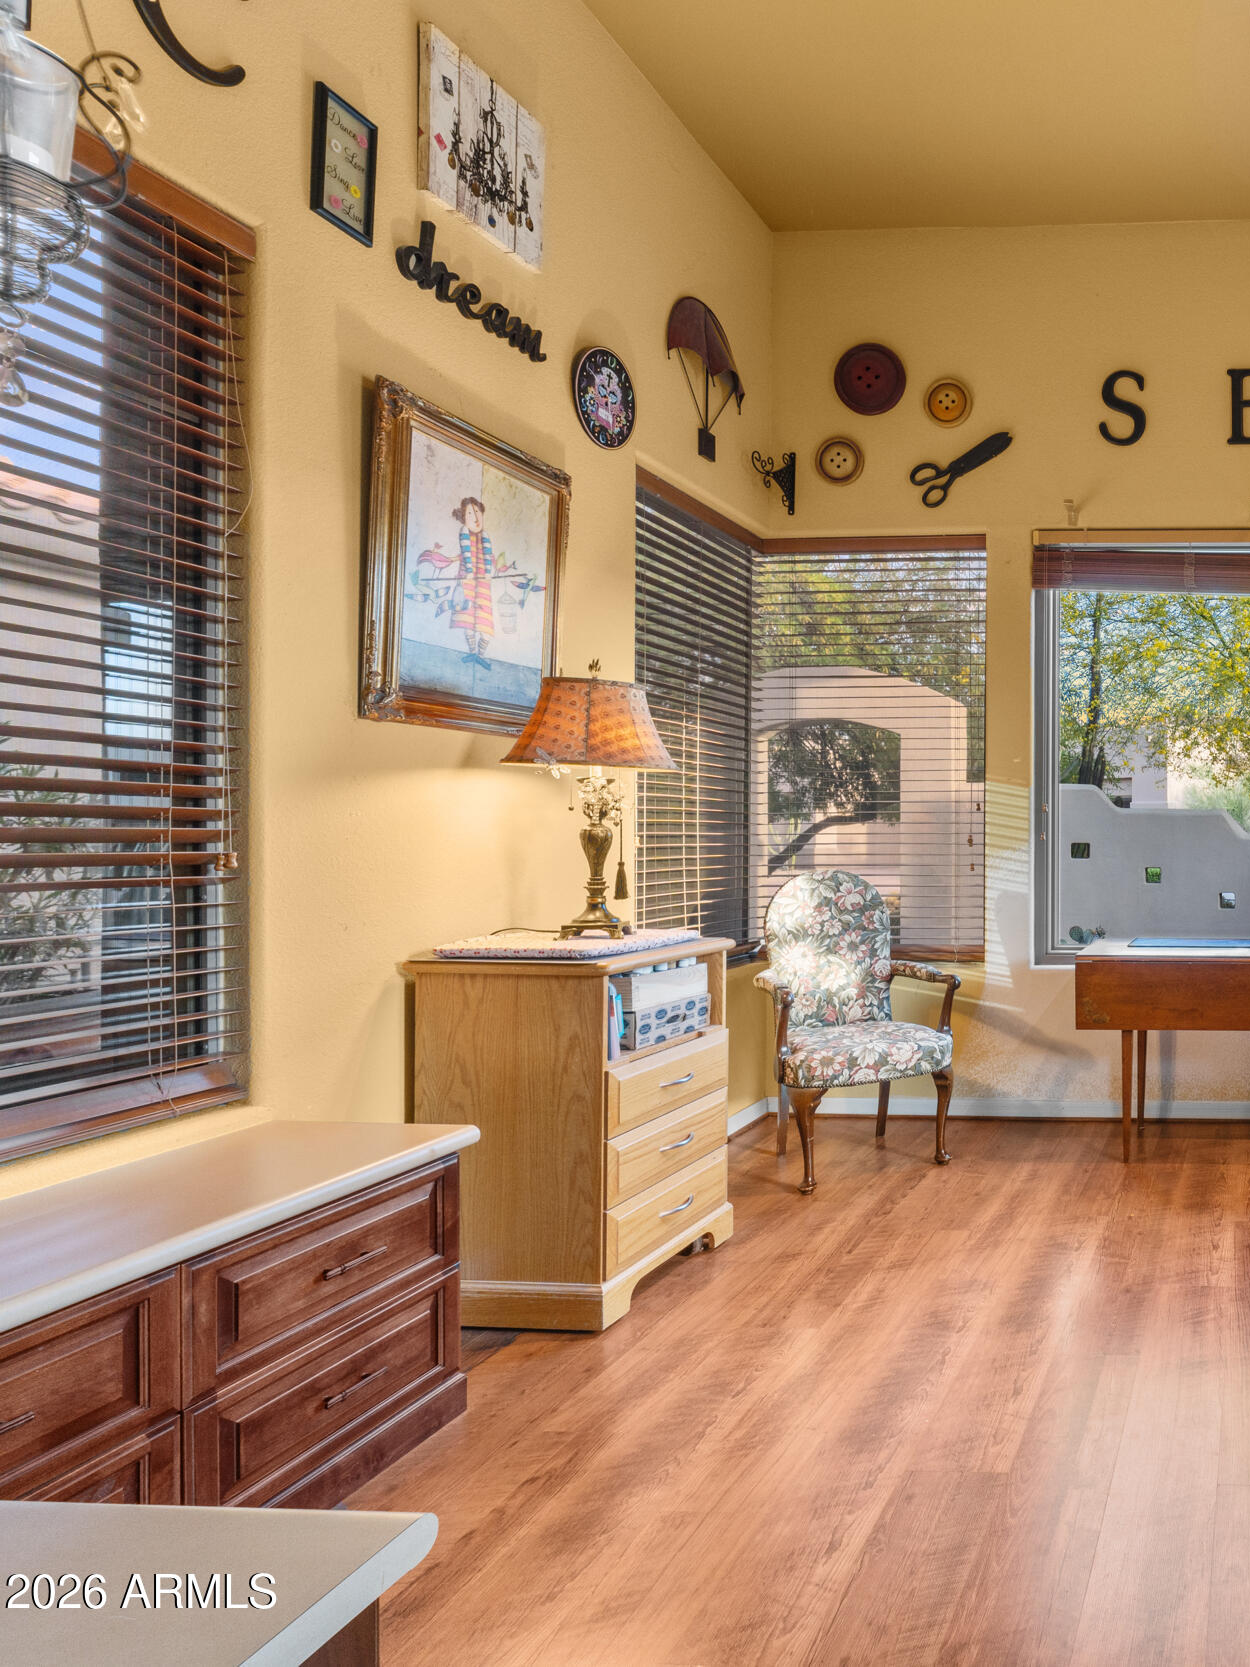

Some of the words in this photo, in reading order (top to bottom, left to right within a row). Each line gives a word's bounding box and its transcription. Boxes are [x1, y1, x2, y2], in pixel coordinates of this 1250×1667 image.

[328, 107, 357, 140] Dance
[344, 147, 366, 173] Love
[327, 164, 349, 192] Sing
[341, 198, 363, 226] Live
[395, 220, 547, 362] dream
